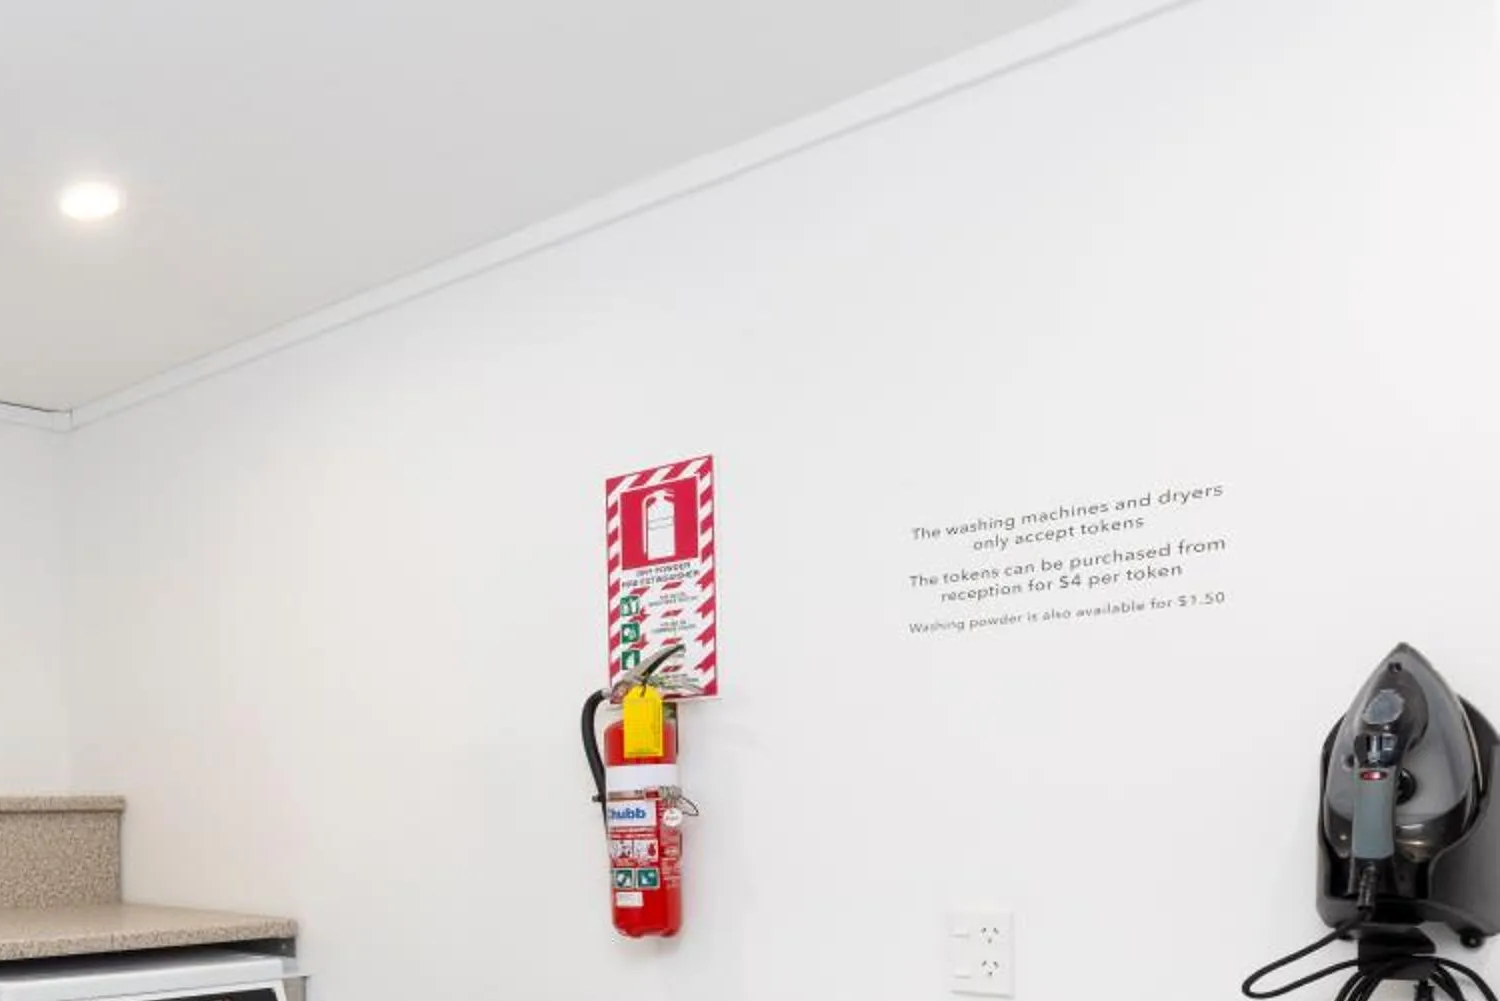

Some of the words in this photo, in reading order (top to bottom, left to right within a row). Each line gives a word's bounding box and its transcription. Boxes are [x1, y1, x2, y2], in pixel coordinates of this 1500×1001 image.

[911, 526, 941, 541] The
[946, 517, 1015, 535] washing
[1021, 503, 1109, 525] machines
[1115, 492, 1151, 511] and
[1158, 485, 1224, 505] dryers
[973, 534, 1008, 551] only
[1015, 525, 1075, 545] accept
[1081, 517, 1145, 535] tokens
[909, 575, 939, 587] The
[943, 568, 1000, 584] tokens
[1004, 563, 1035, 577] can
[1041, 559, 1063, 572] be
[1070, 543, 1171, 571] purchased
[1178, 538, 1226, 556] from
[941, 582, 1022, 602] reception
[1028, 578, 1052, 592] for
[1059, 573, 1082, 589] $4
[1089, 572, 1120, 589] per
[1126, 565, 1183, 581] token
[909, 619, 965, 634] Washing
[969, 613, 1022, 631] powder
[1028, 611, 1038, 622] is
[1042, 608, 1071, 622] also
[1076, 600, 1145, 617] available
[1151, 597, 1173, 610] for
[1178, 591, 1225, 607] $1.50
